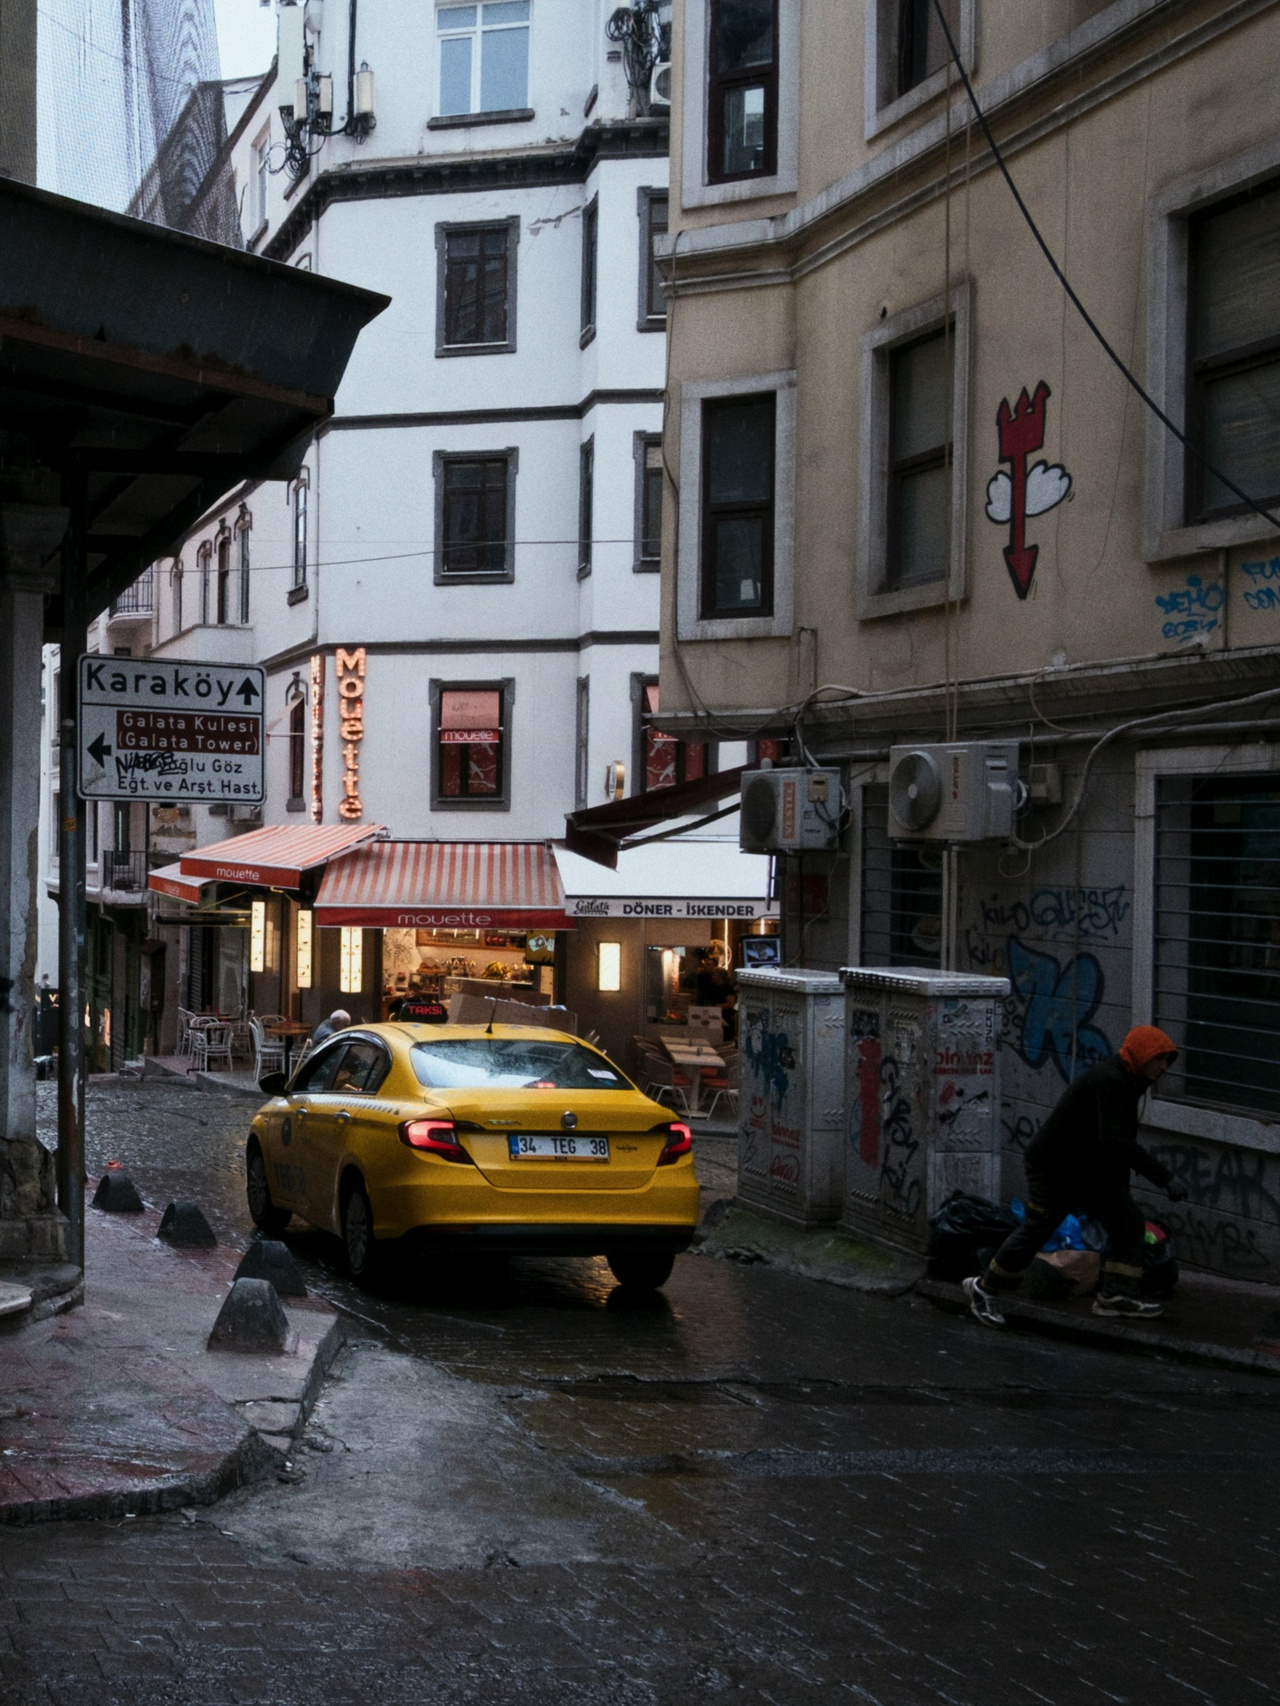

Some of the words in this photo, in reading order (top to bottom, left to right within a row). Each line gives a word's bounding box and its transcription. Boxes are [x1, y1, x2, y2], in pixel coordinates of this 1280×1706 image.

[86, 663, 234, 706] Karaköy
[123, 713, 186, 730] Galata
[194, 717, 254, 733] Kulesi
[118, 732, 189, 749] (Galata
[195, 735, 259, 753] Tower)
[212, 759, 243, 774] Göz
[118, 776, 149, 793] Eğt.
[154, 781, 173, 791] ve
[178, 778, 215, 794] Arşt.
[221, 780, 260, 794] Hast.
[216, 867, 260, 881] mouette
[623, 902, 673, 915] DÖNER
[686, 902, 754, 916] İSKENDER
[397, 912, 492, 926] mouette
[520, 1137, 536, 1153] 34
[551, 1138, 576, 1154] TEG
[590, 1140, 606, 1155] 38
